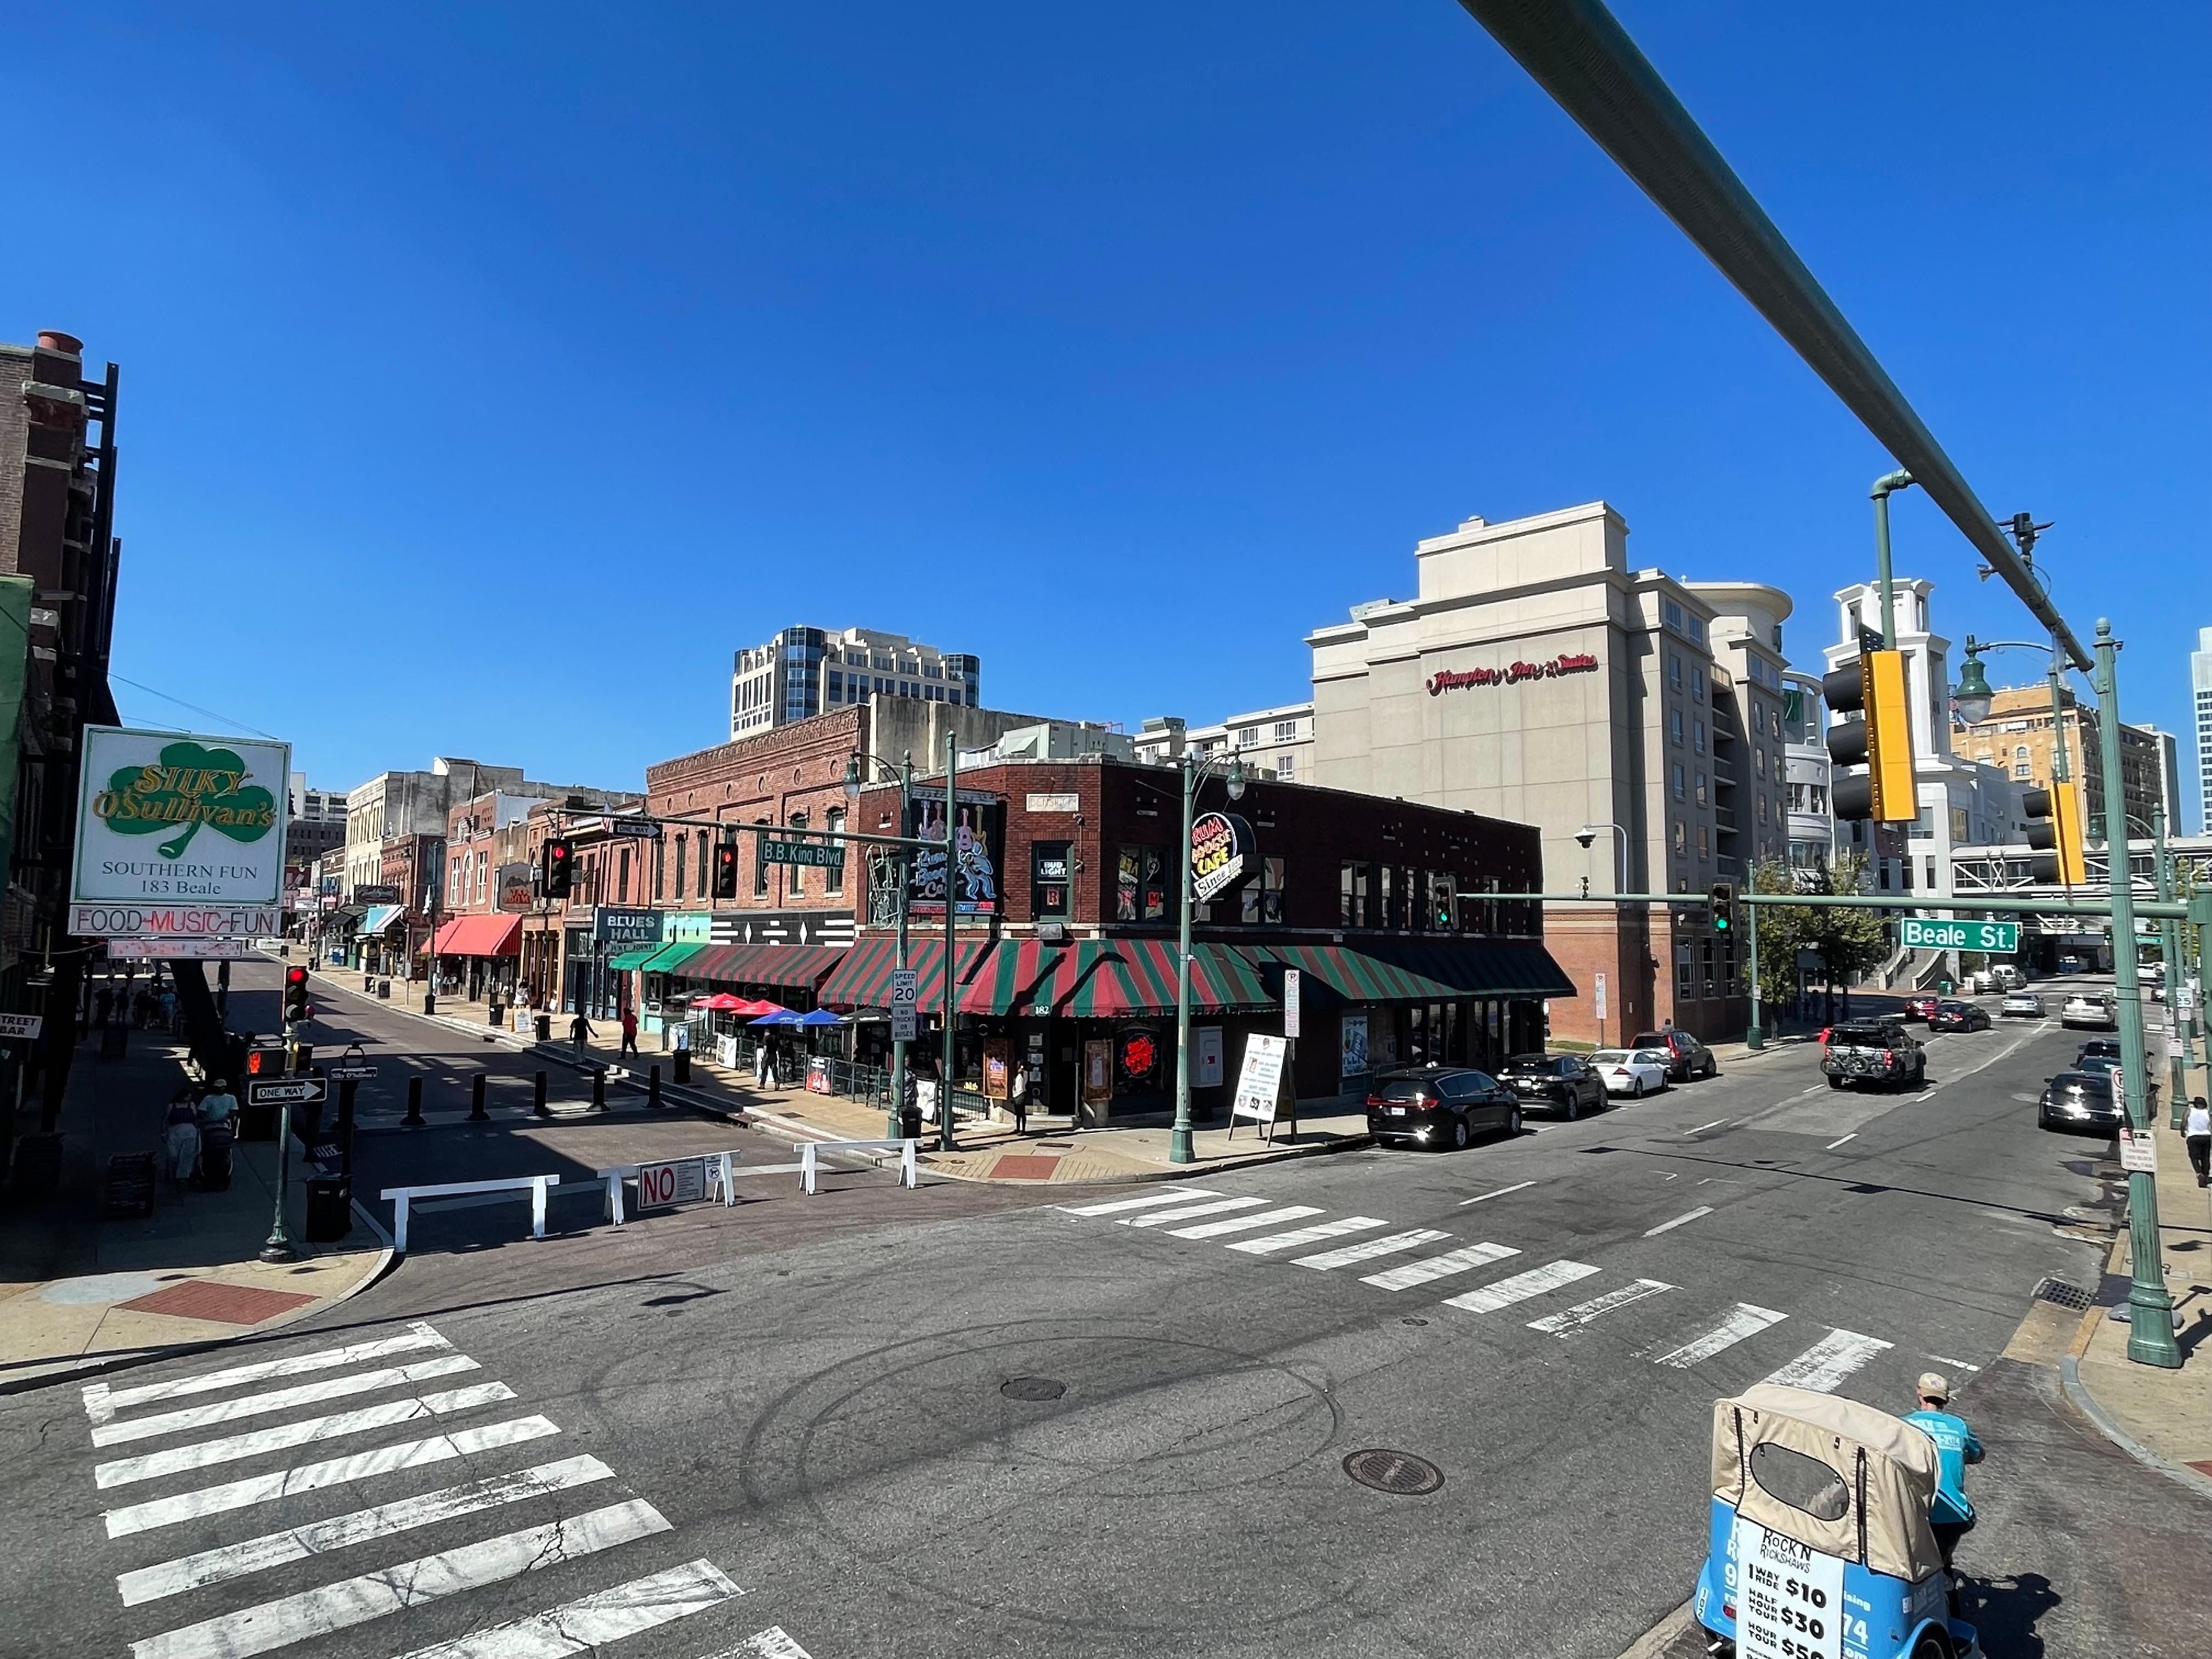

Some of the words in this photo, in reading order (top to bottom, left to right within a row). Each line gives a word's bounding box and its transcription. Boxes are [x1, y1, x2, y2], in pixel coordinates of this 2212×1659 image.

[1426, 667, 1502, 695] Hampton
[1503, 661, 1543, 682] Inn
[1557, 653, 1598, 675] Suites
[135, 765, 253, 799] SILKY
[93, 789, 276, 827] O'Sullivan's
[1192, 817, 1224, 845] RUM
[789, 845, 812, 865] King
[816, 848, 843, 865] Blvd.
[102, 861, 213, 878] SOUTHERN
[220, 866, 258, 879] FUN
[142, 881, 170, 893] 183
[177, 881, 221, 894] Beale
[1198, 871, 1226, 894] Since
[607, 916, 655, 928] BLUES
[611, 928, 648, 940] HALL
[1906, 922, 1966, 946] Beale
[1979, 925, 2014, 949] St.
[895, 988, 915, 1001] 20
[1035, 1006, 1049, 1014] 182
[0, 1015, 37, 1026] TREET
[260, 1088, 280, 1097] ONE
[284, 1086, 305, 1096] WAY
[644, 1167, 675, 1204] NO
[1748, 1563, 1754, 1579] 1
[1756, 1566, 1779, 1581] WAY
[1756, 1575, 1779, 1590] RIDE
[1749, 1588, 1778, 1604] HALF
[1786, 1578, 1827, 1609] $10
[1749, 1596, 1778, 1615] HOUR
[1749, 1605, 1778, 1623] TOUR
[1748, 1621, 1777, 1640] HOUR
[1781, 1606, 1825, 1639] $30
[1748, 1629, 1778, 1649] TOUR
